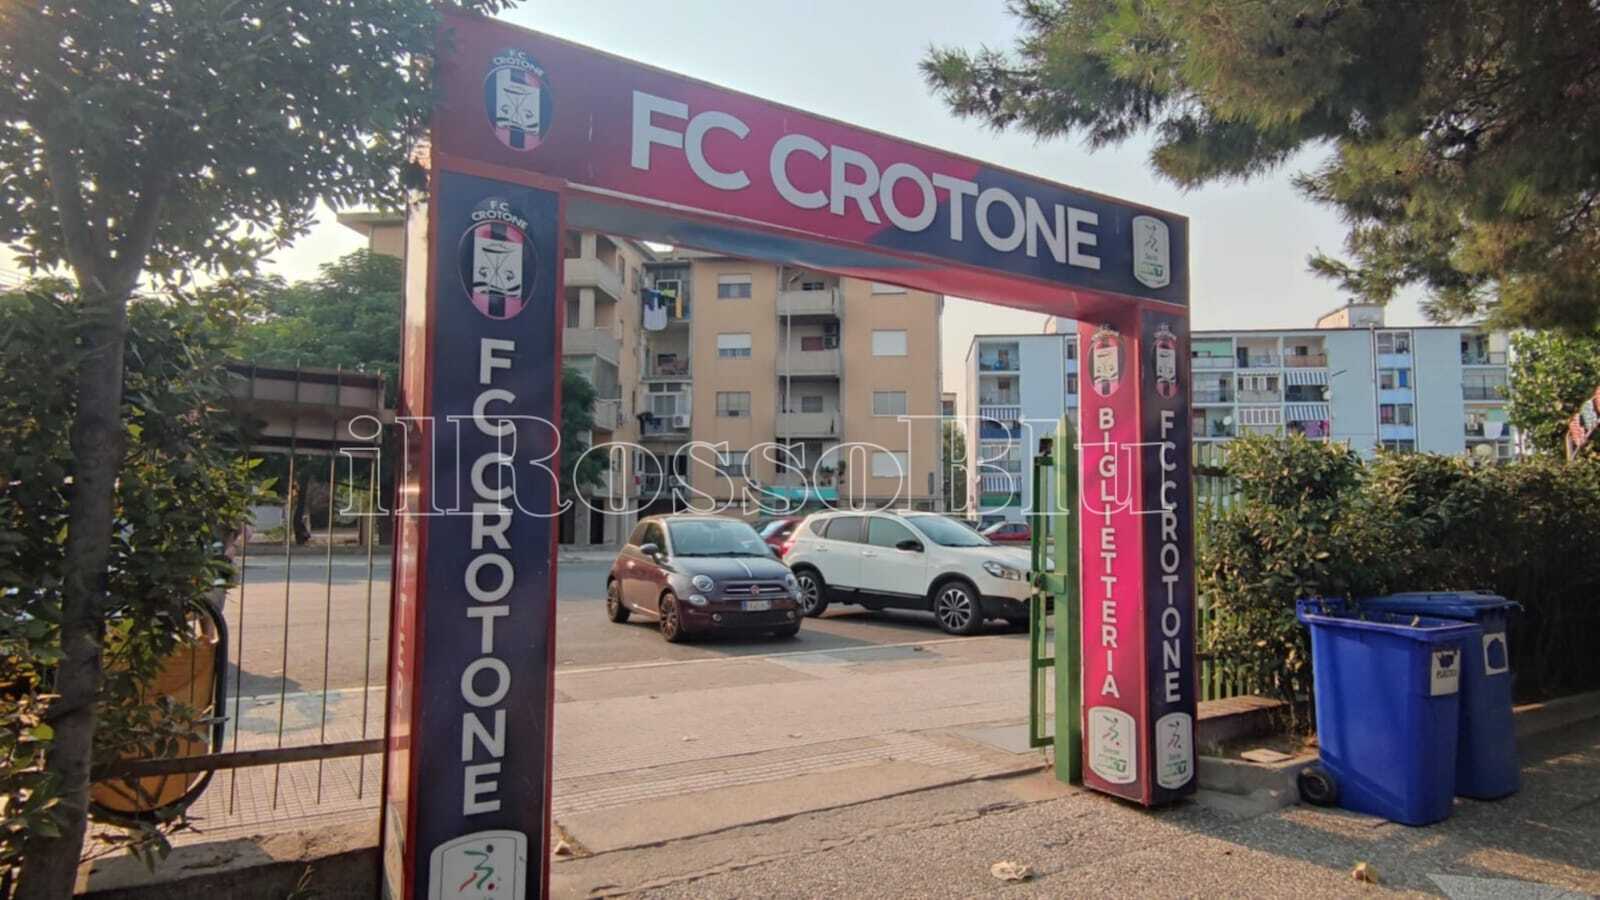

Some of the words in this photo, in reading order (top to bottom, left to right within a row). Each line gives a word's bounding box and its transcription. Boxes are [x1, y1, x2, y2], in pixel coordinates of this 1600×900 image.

[471, 210, 528, 230] CROTONE
[632, 90, 750, 190] FC
[769, 134, 1100, 269] CROTONE
[473, 337, 516, 437] FC
[460, 452, 515, 816] CROTONE
[1099, 408, 1120, 697] BIGLIETTERIA
[1160, 481, 1181, 702] CROTONE
